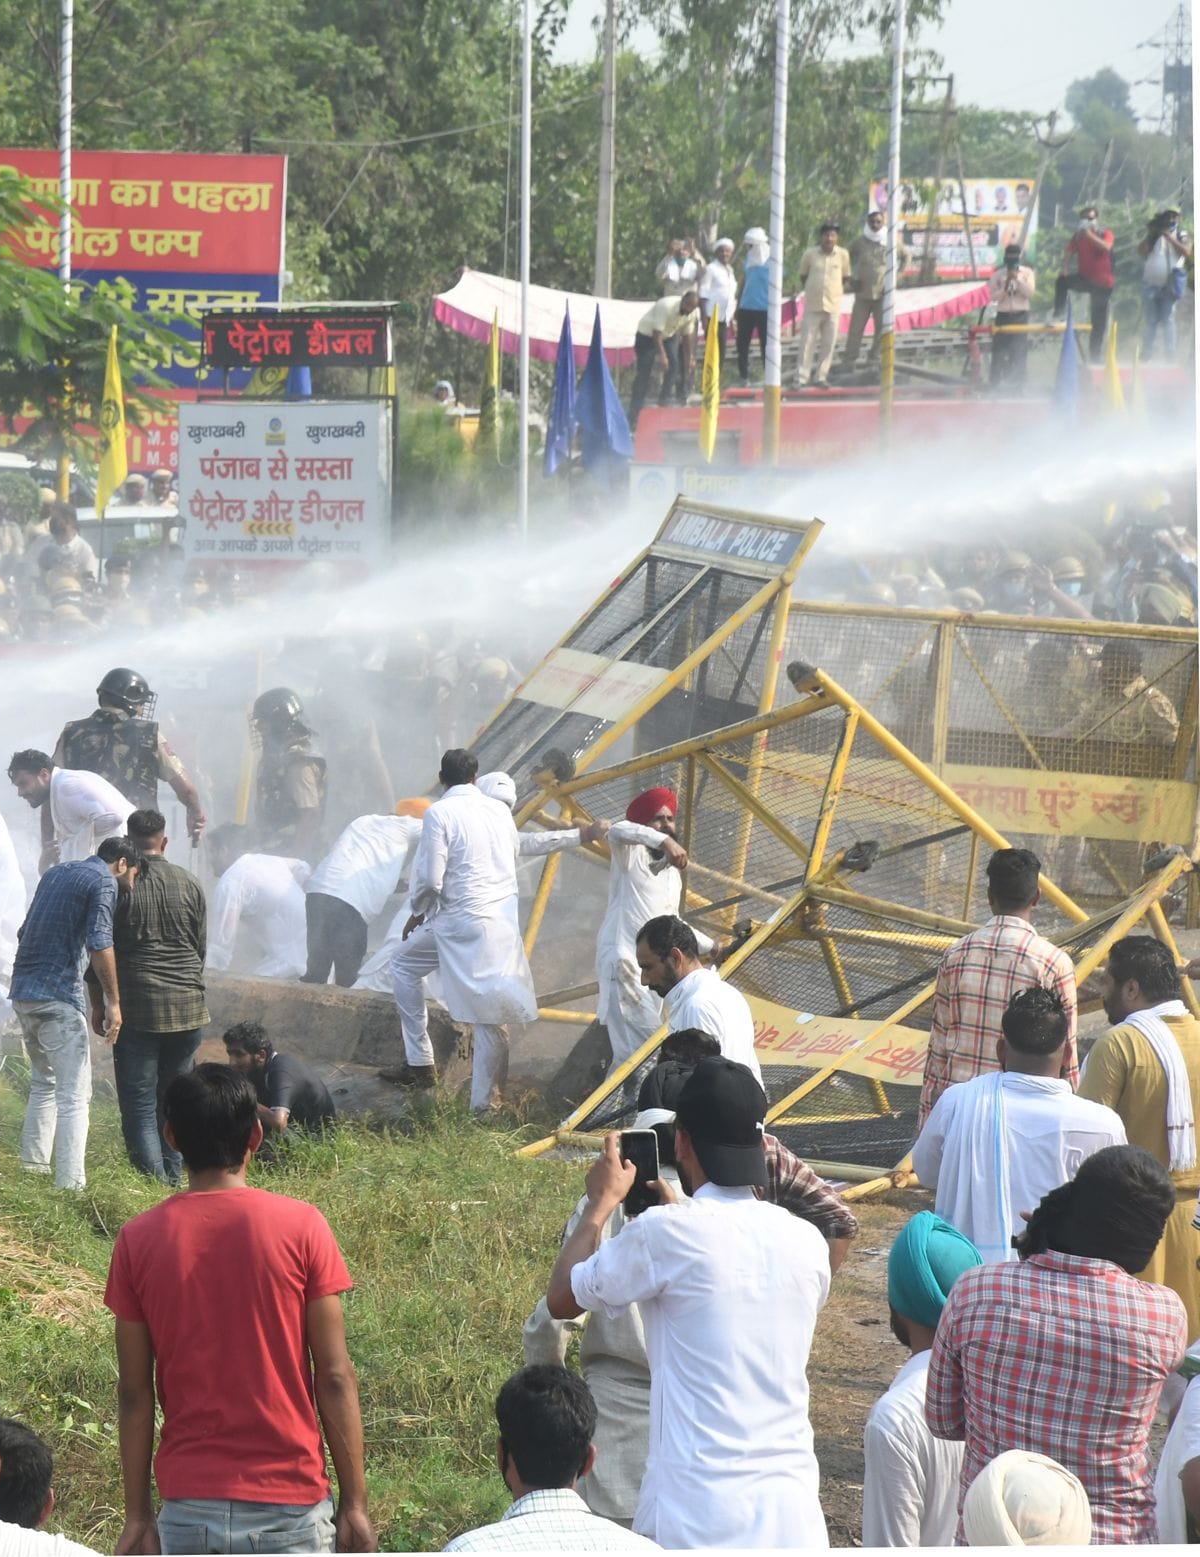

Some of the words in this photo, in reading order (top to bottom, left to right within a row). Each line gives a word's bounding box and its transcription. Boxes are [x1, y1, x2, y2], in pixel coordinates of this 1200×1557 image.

[109, 178, 163, 208] का
[171, 181, 274, 213] पहला
[128, 229, 202, 258] पम्प
[187, 421, 246, 444] खुशखबरी
[306, 421, 366, 444] खुशखबरी
[199, 448, 261, 480] पंजाब
[267, 449, 289, 480] से
[294, 457, 354, 481] सस्ता
[252, 489, 294, 522] और
[668, 513, 733, 551] AMBALA
[727, 526, 790, 562] POLICE
